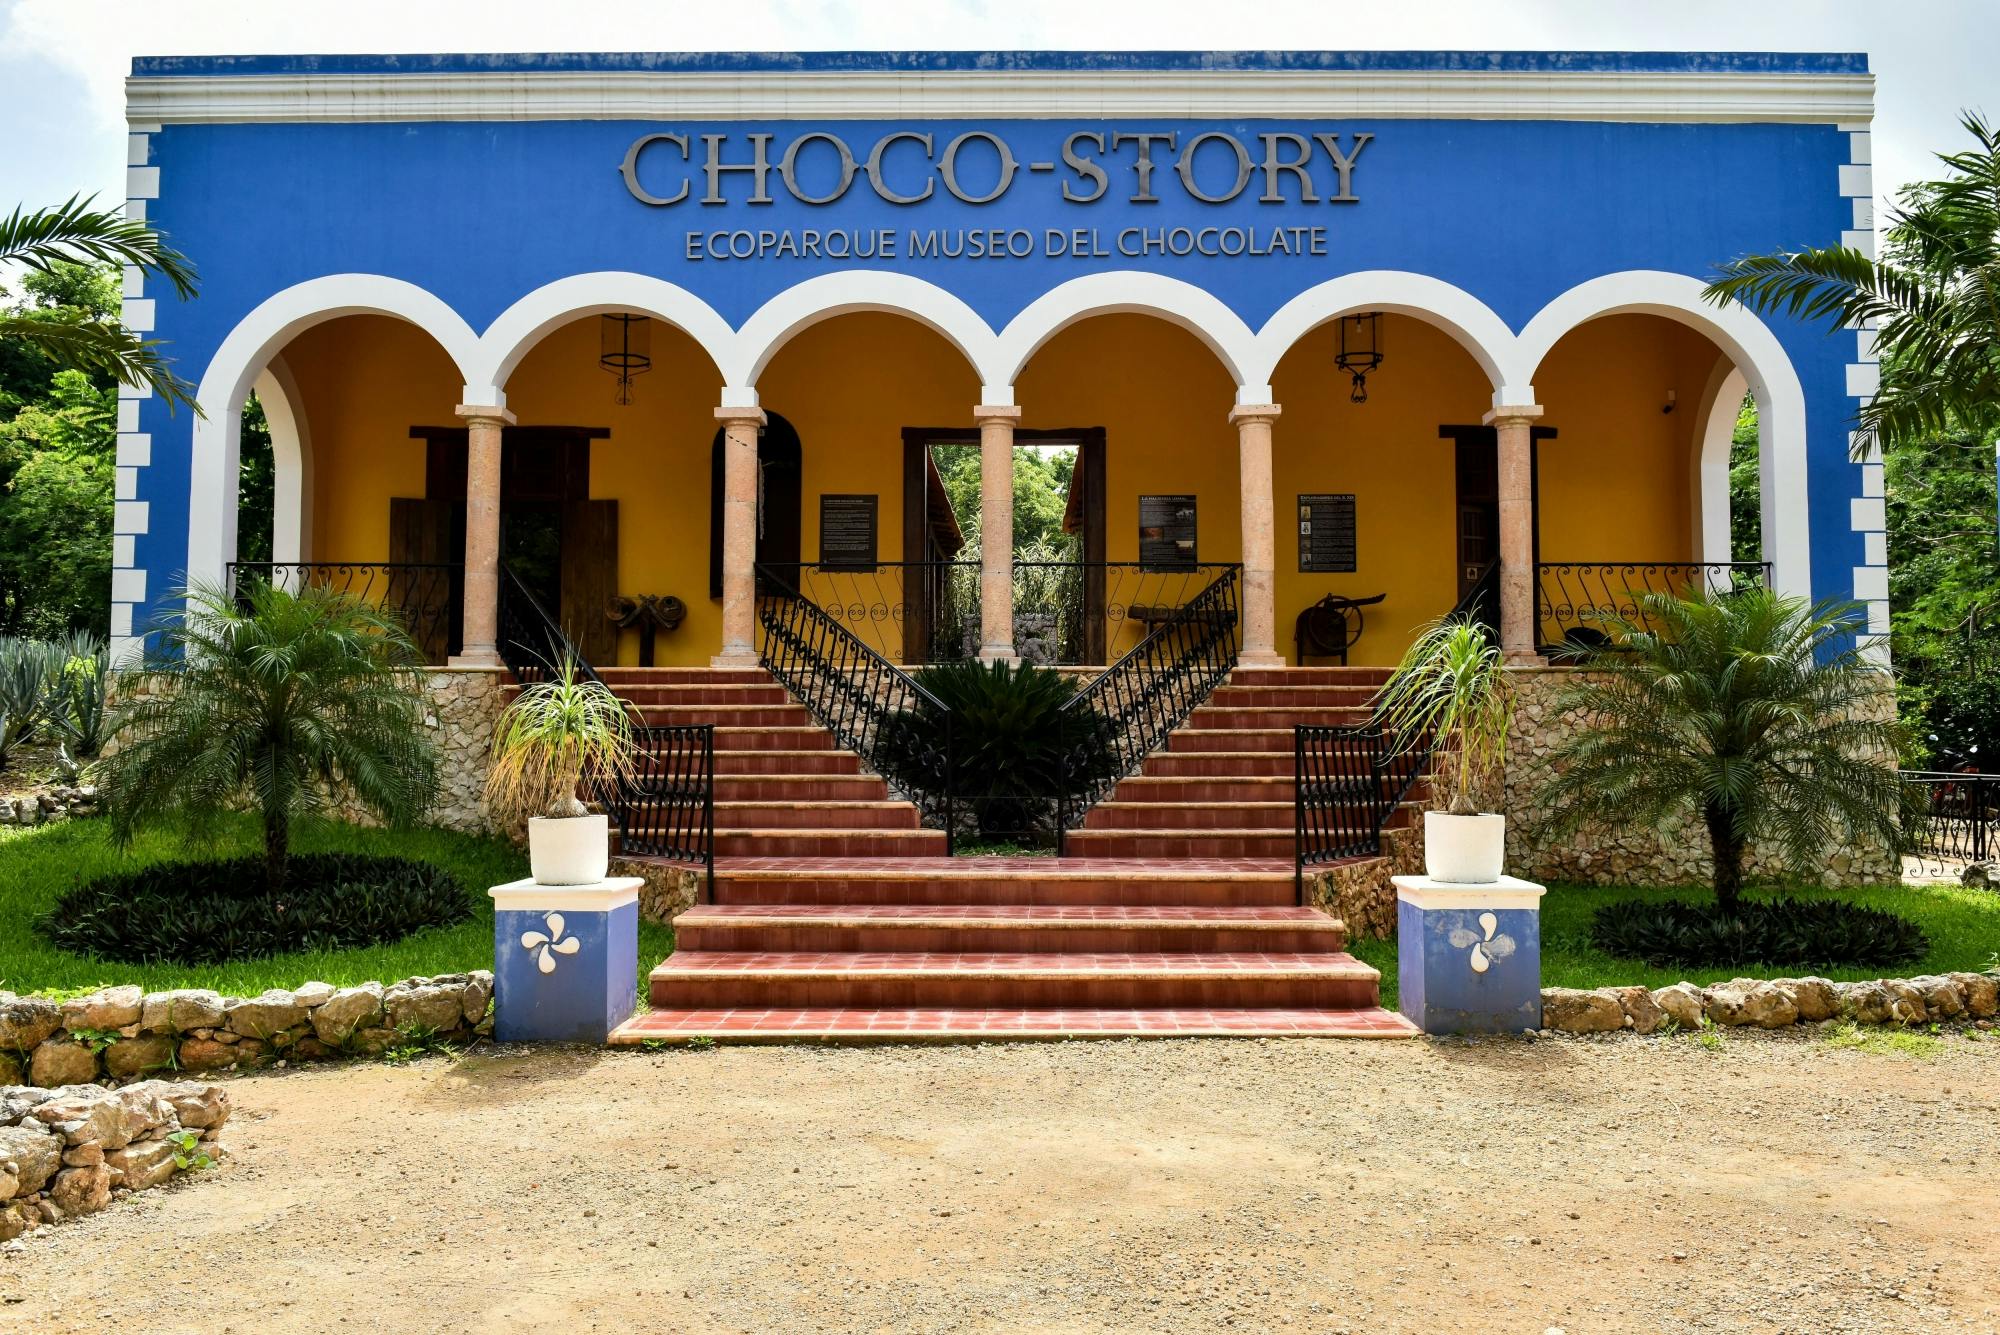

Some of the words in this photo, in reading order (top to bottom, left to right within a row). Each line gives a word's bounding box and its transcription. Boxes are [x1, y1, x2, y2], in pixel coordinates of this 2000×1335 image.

[618, 131, 1375, 205] CHOCO-STORY
[685, 229, 896, 260] ECOPARQUE
[908, 228, 1034, 257] MUSEO
[1045, 228, 1110, 257] DEL
[1117, 226, 1328, 255] CHOCOLATE
